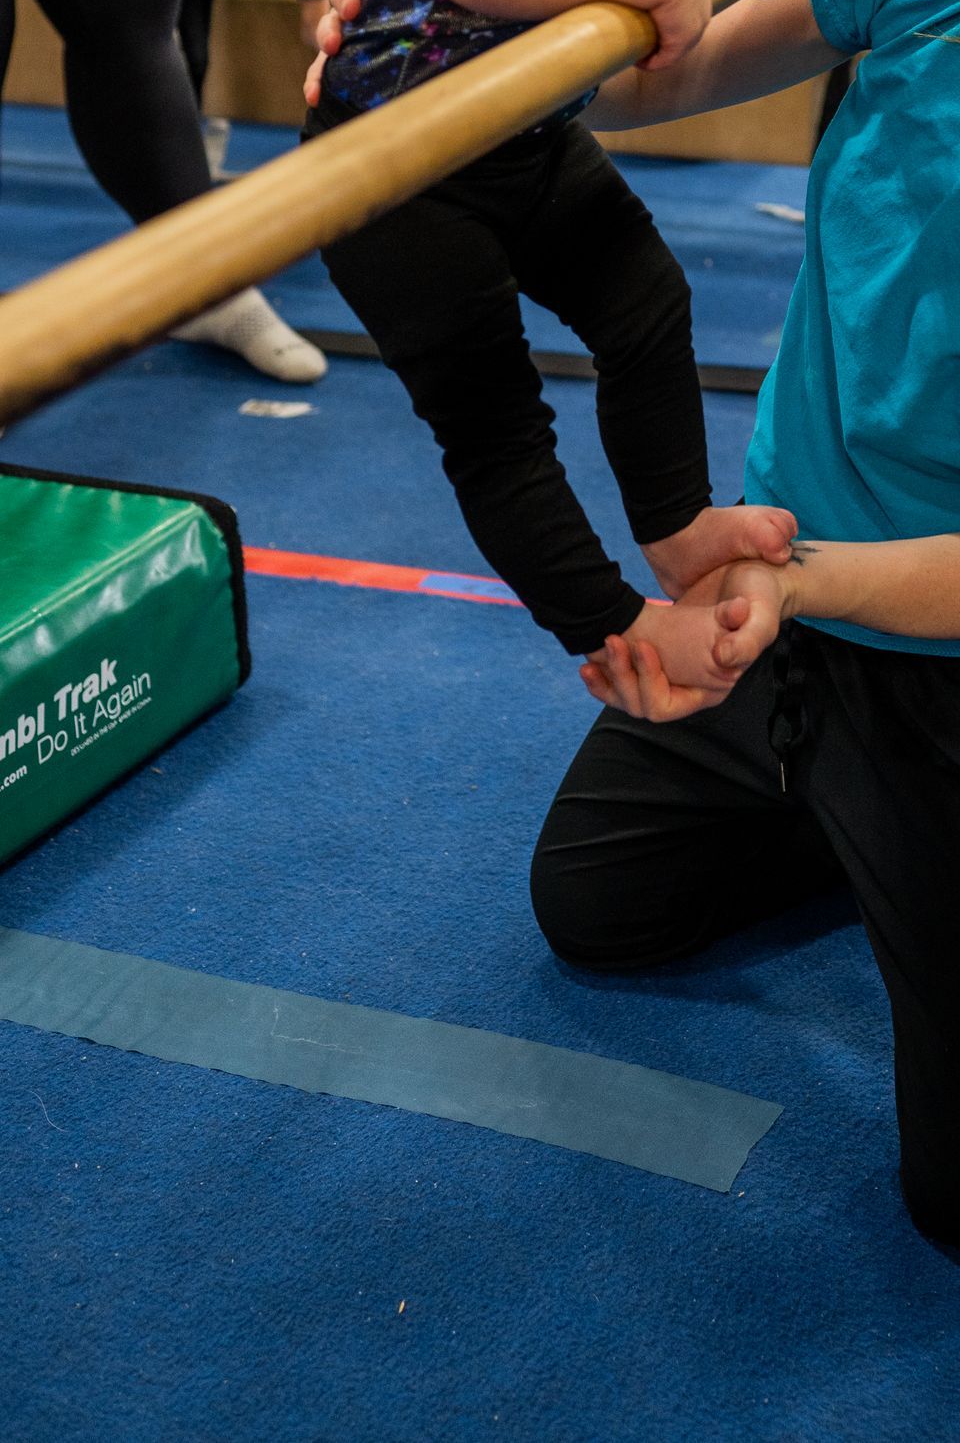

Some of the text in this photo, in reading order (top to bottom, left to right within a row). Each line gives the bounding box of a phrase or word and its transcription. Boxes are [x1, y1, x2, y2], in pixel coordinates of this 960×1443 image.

[37, 672, 151, 765] Do It Again
[54, 658, 117, 721] Trak
[0, 765, 28, 792] .com
